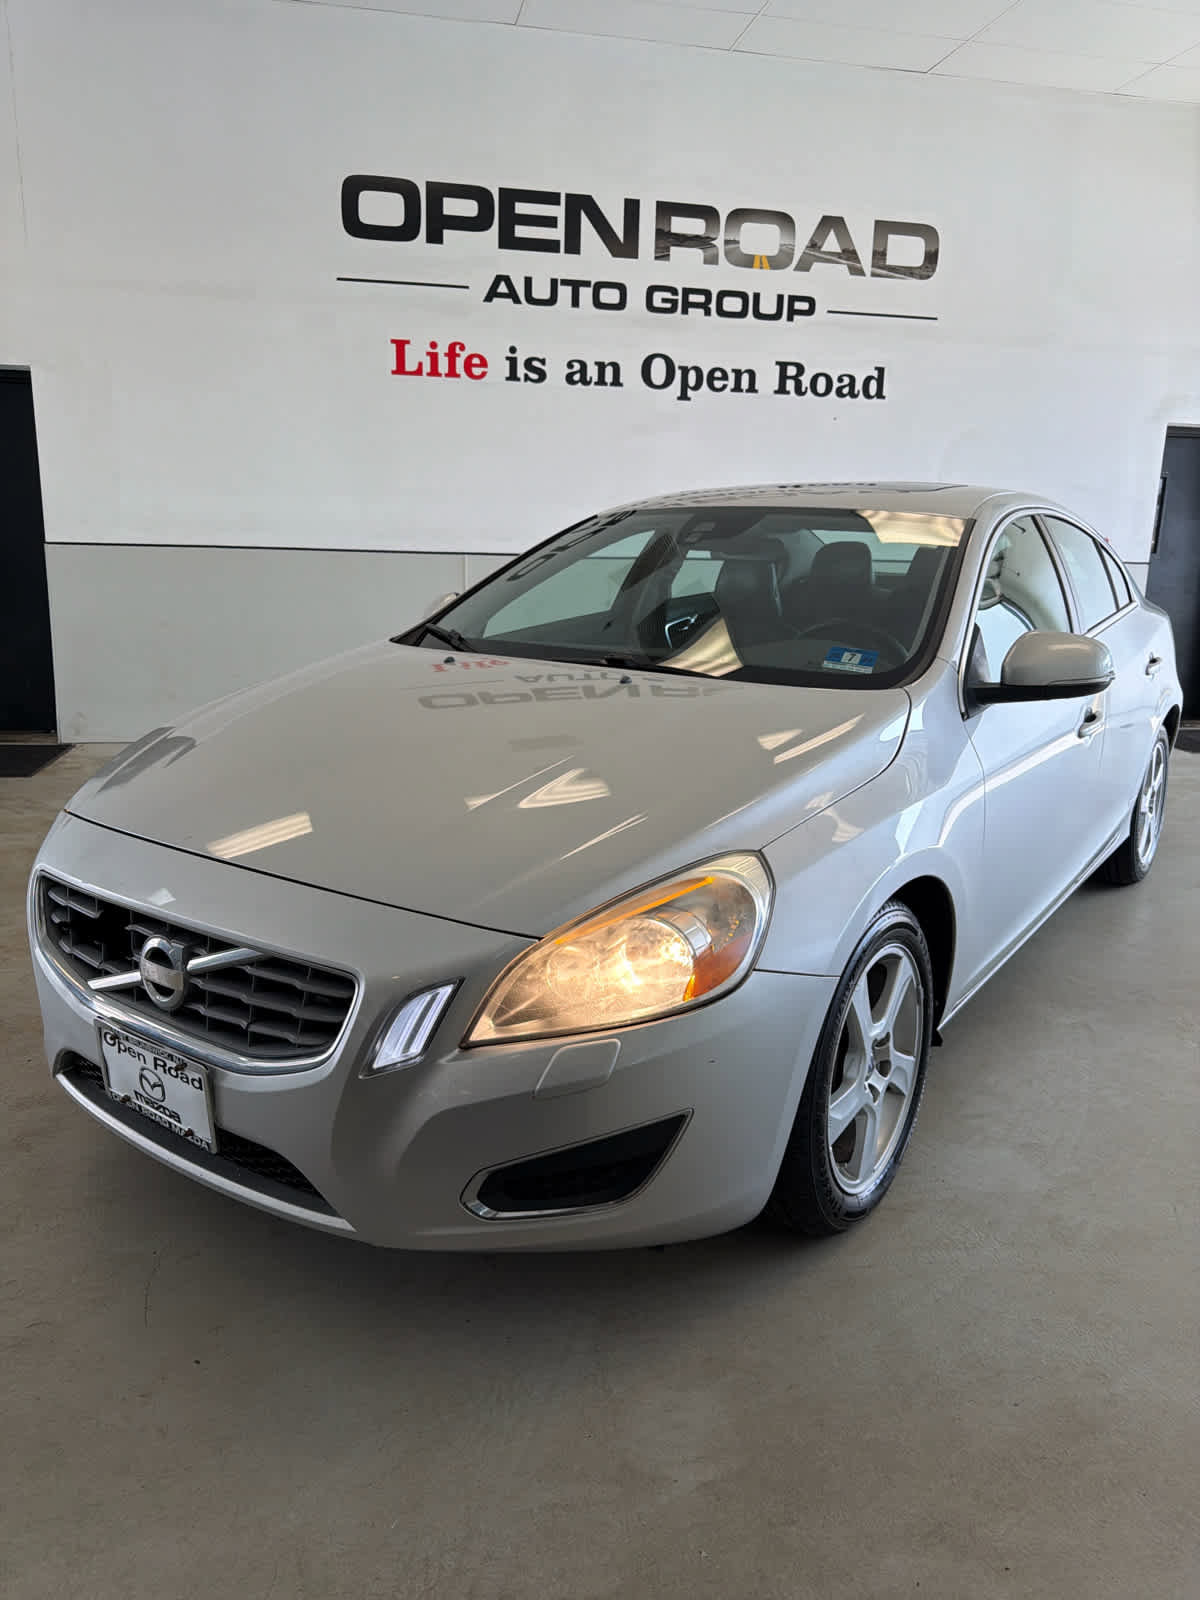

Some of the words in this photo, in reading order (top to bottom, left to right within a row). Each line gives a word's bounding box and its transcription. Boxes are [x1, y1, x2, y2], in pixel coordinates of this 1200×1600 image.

[482, 273, 628, 312] AUTO
[645, 284, 818, 323] GROUP
[389, 338, 489, 381] Life
[504, 345, 548, 385] is
[564, 358, 624, 388] an
[640, 352, 759, 402] Open
[773, 360, 887, 401] Road
[103, 1031, 146, 1065] Open
[153, 1056, 204, 1092] Road
